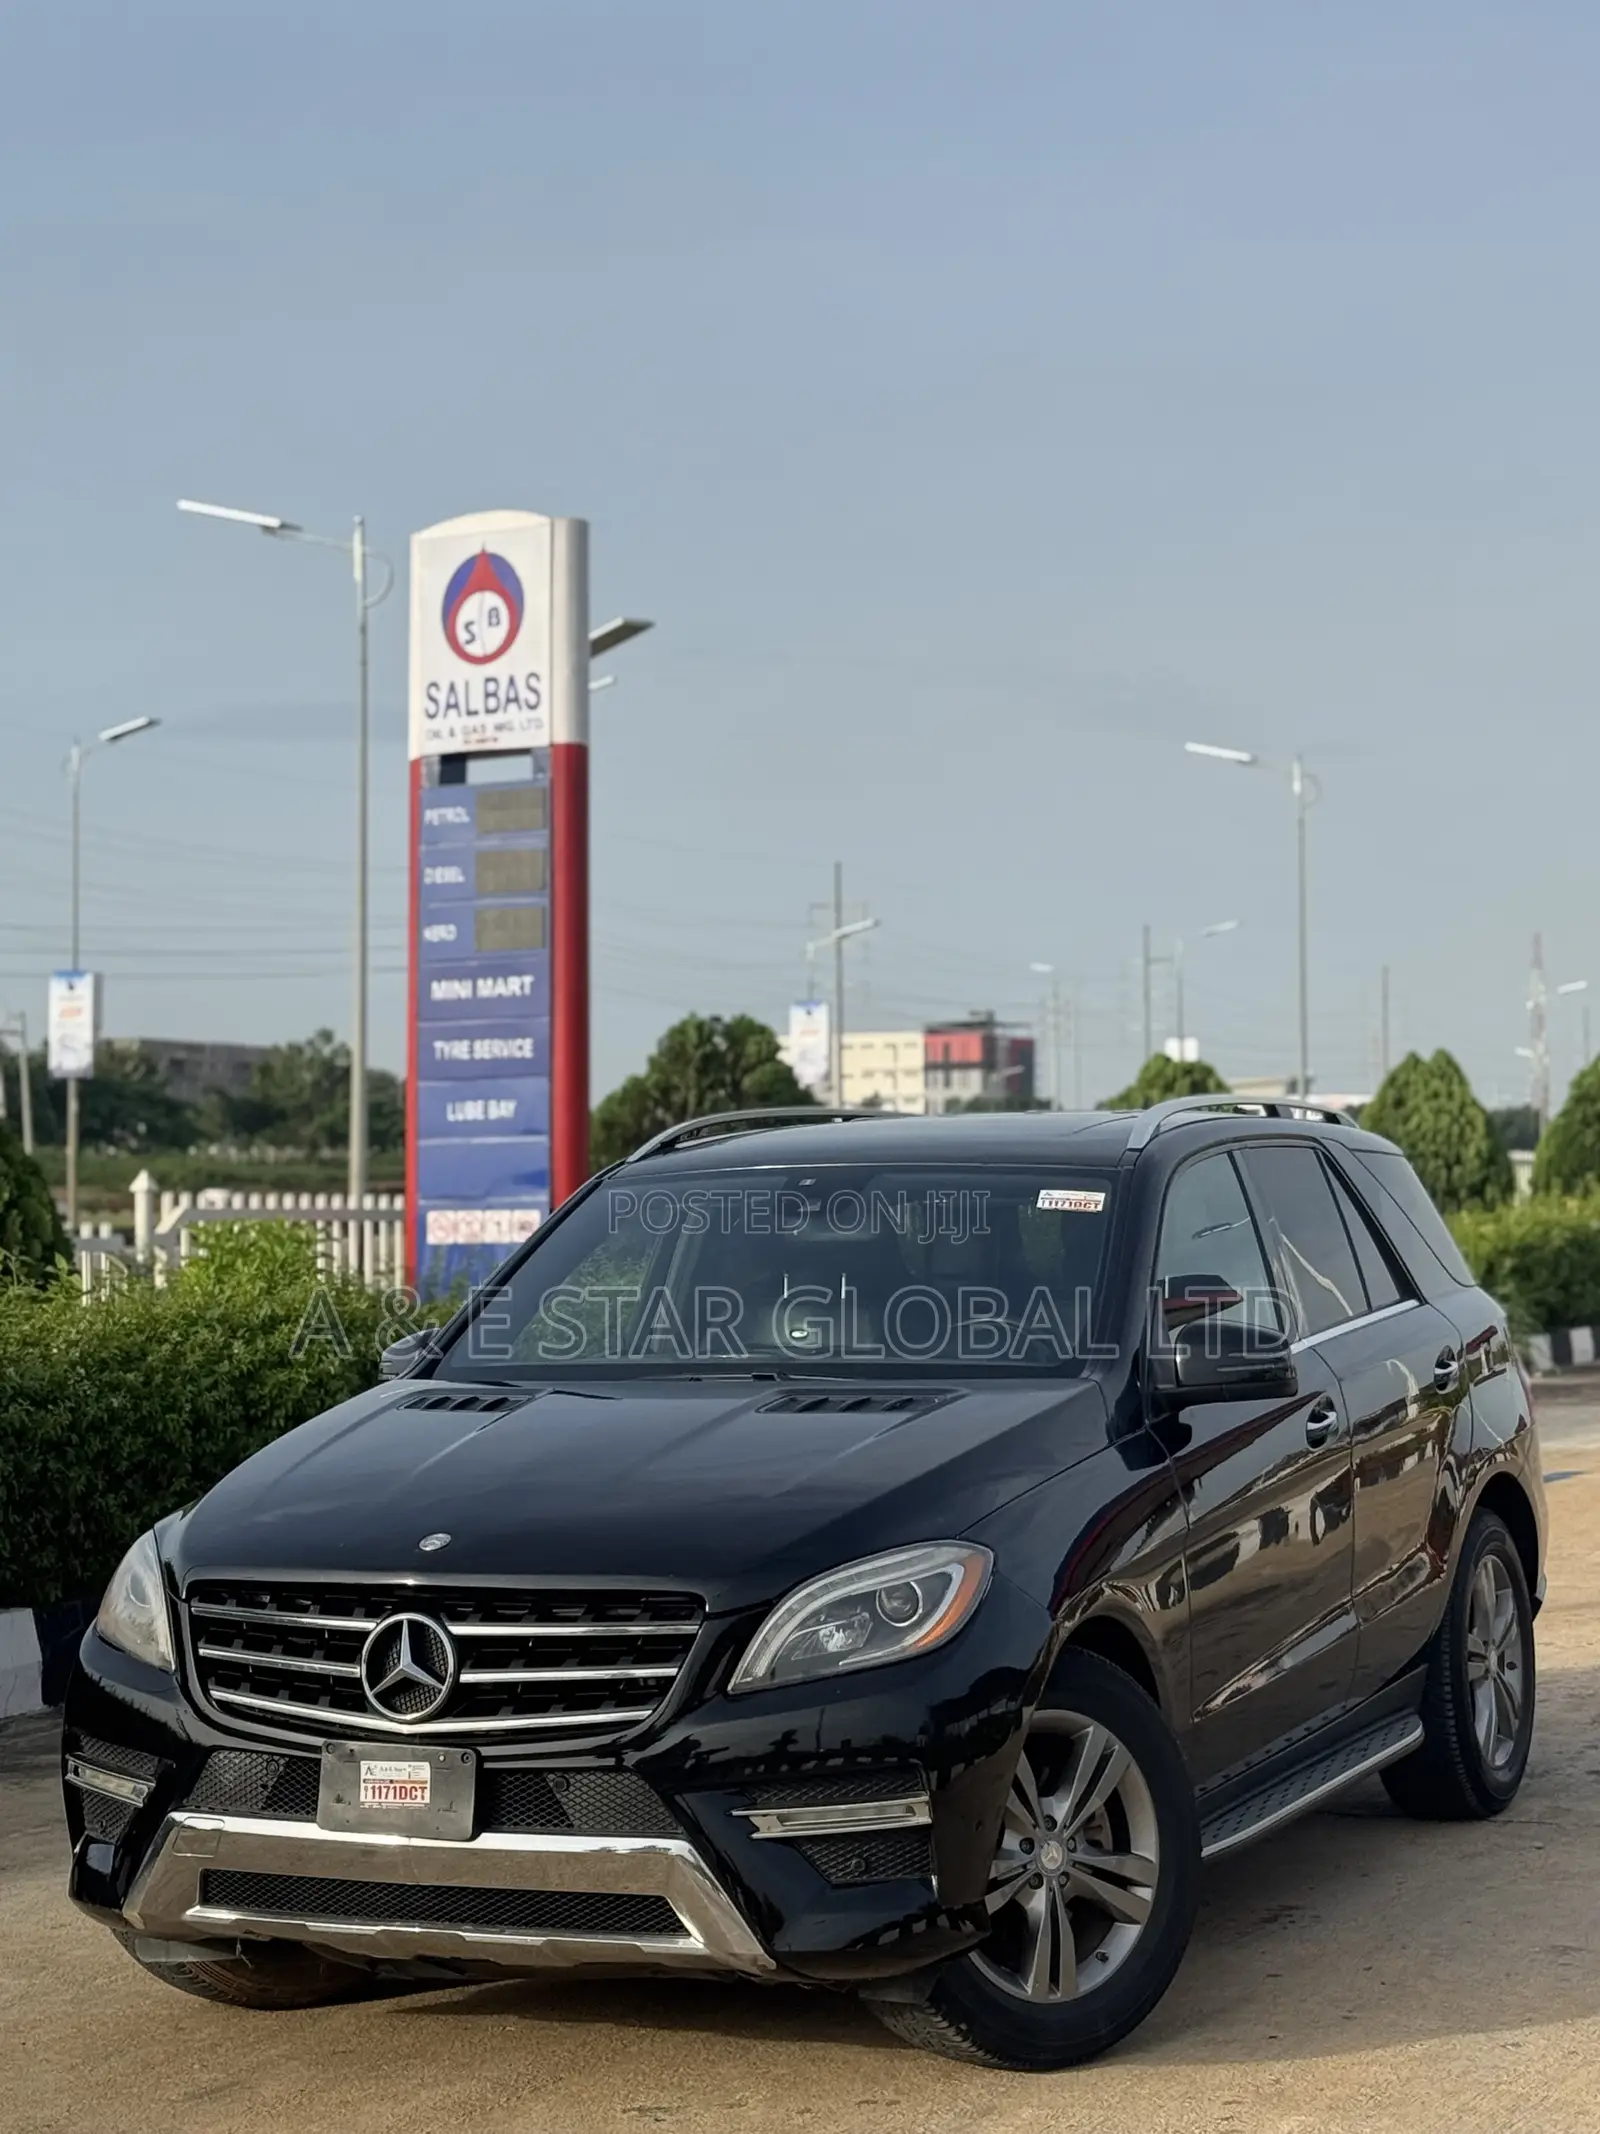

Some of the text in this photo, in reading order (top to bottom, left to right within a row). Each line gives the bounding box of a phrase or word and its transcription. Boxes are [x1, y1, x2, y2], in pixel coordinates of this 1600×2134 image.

[424, 672, 541, 720] SALBAS
[430, 975, 535, 1001] MINI MART
[433, 1037, 534, 1061] TYRE SERVICE
